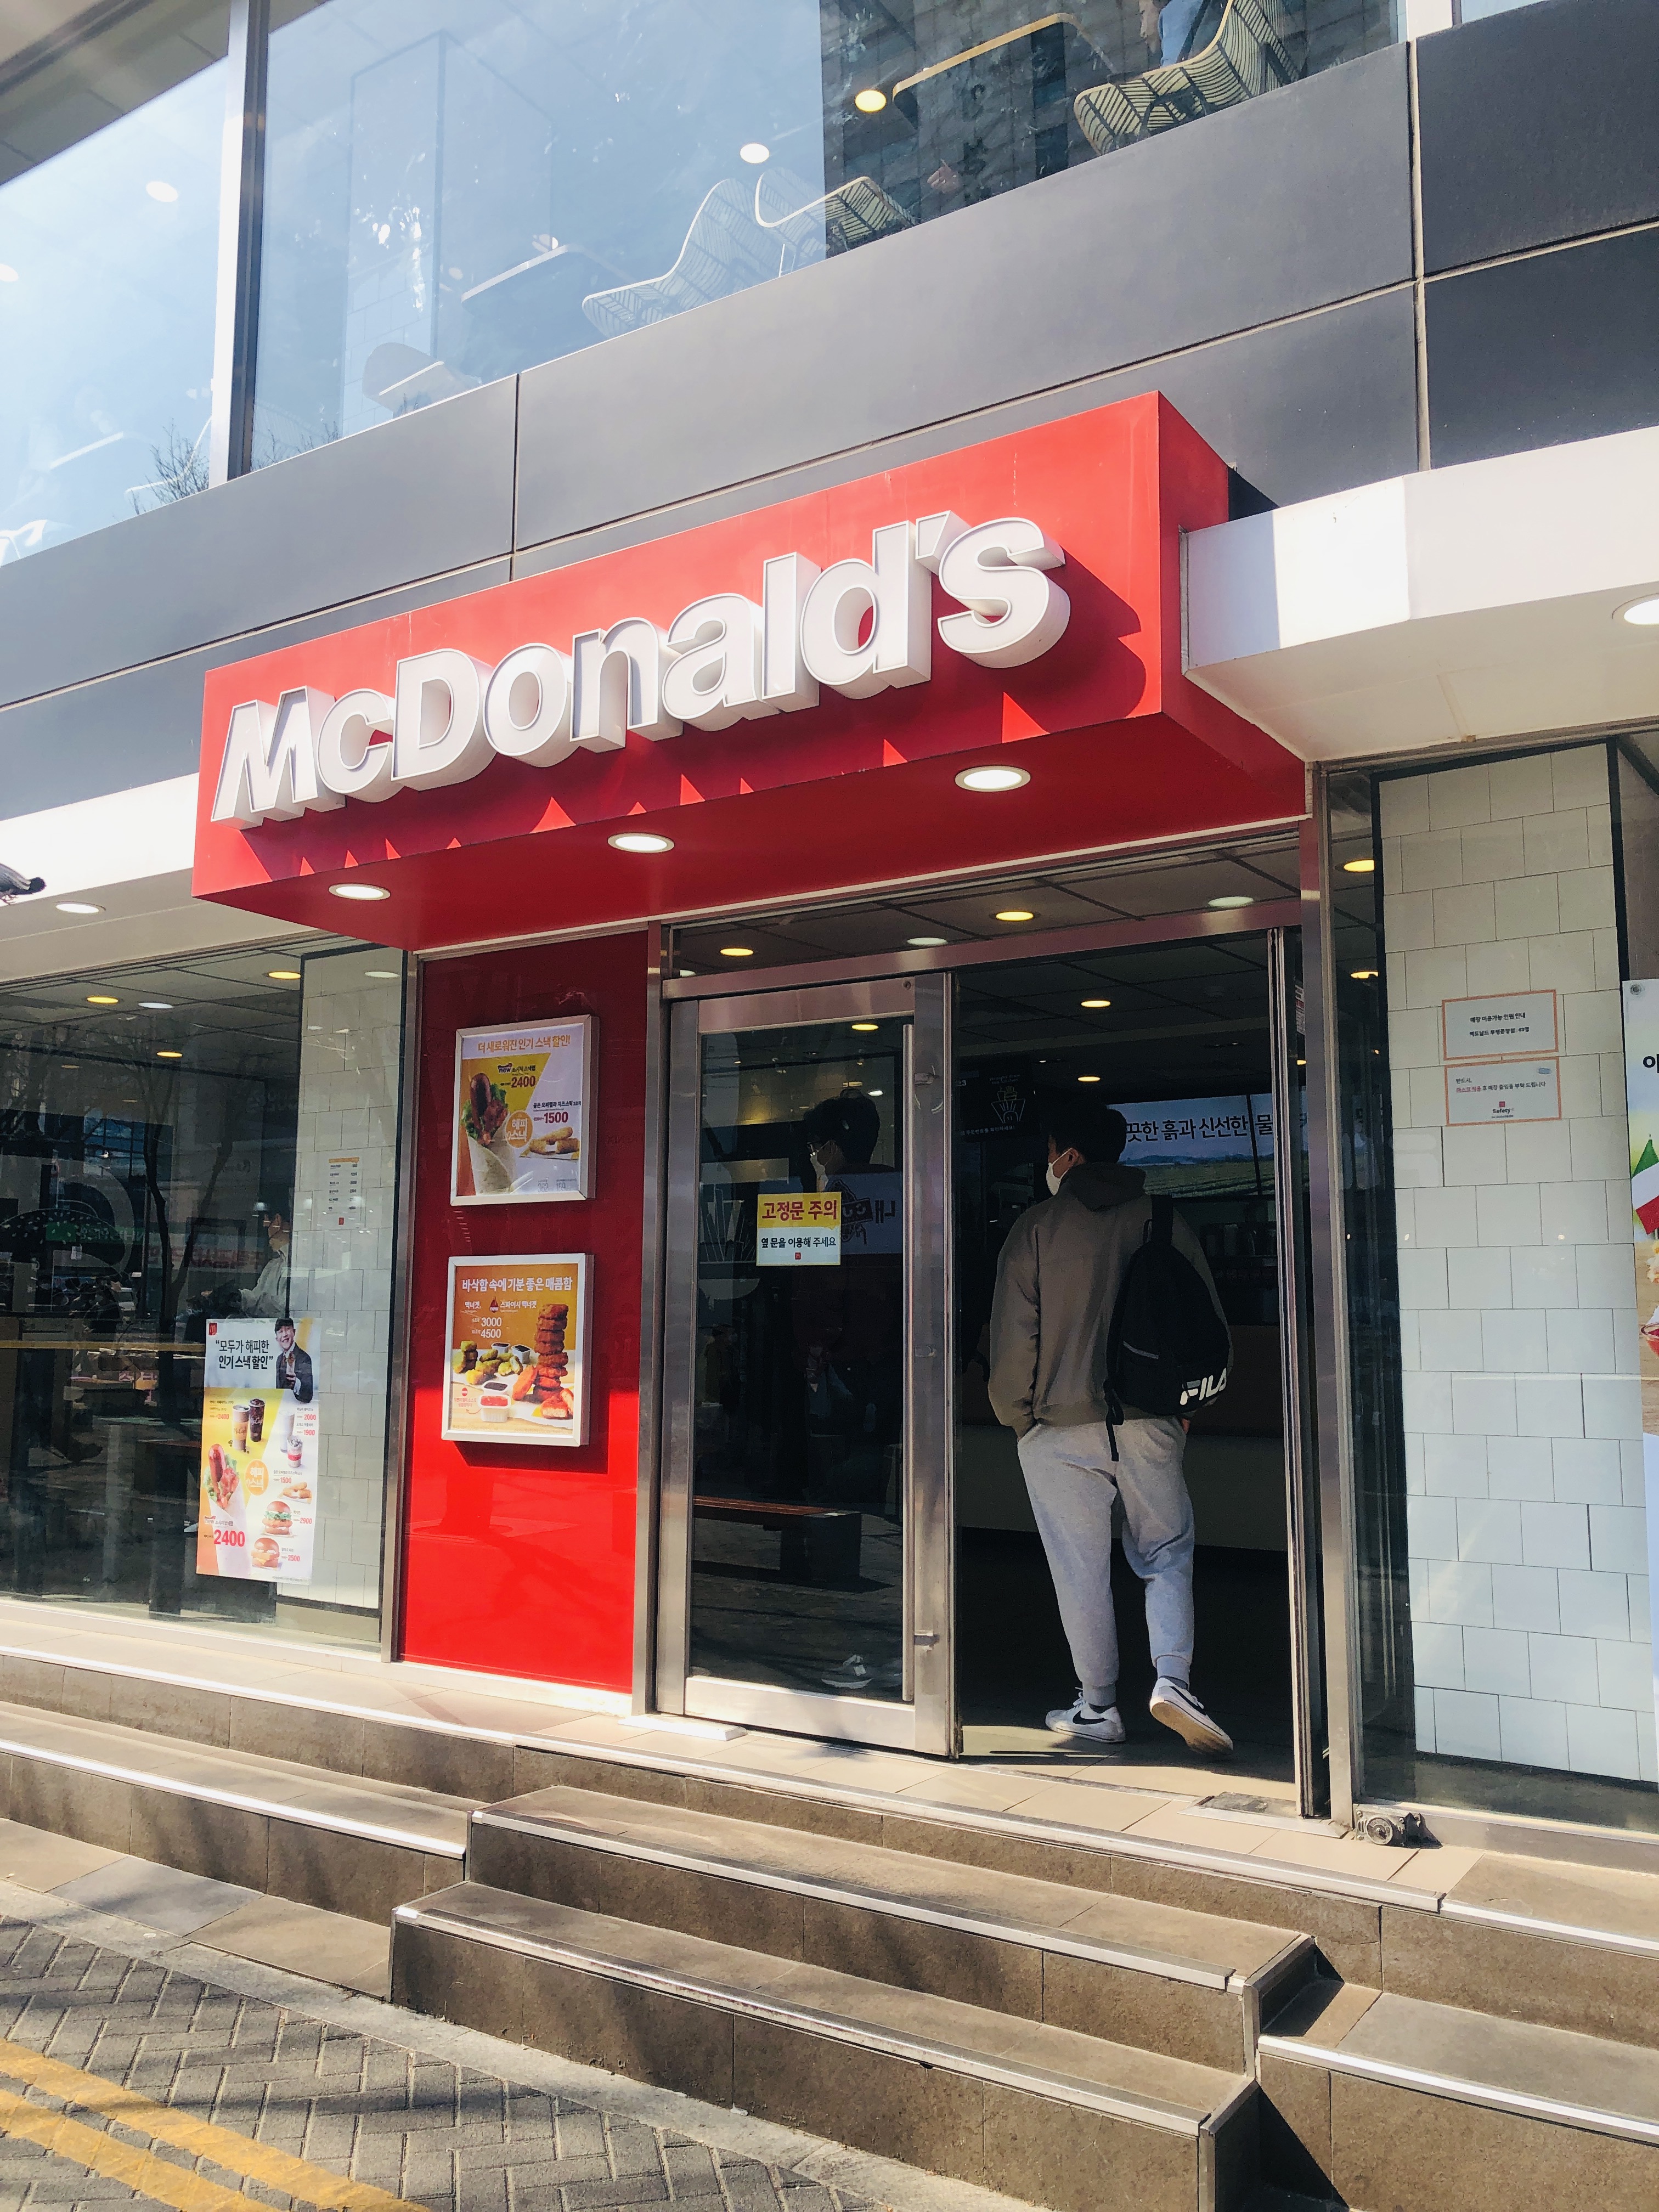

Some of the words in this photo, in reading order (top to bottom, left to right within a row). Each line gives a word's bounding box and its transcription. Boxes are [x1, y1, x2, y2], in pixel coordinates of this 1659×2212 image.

[211, 510, 1070, 830] McDonald's
[478, 1042, 486, 1053] 더
[487, 1039, 517, 1053] 새로워진
[518, 1038, 534, 1049] 인기
[535, 1036, 551, 1048] 스낵
[511, 1075, 536, 1088] 2400
[511, 1118, 528, 1130] 해피
[544, 1111, 568, 1124] 1500
[1161, 1118, 1196, 1141] 흙과
[1199, 1115, 1249, 1139] 신선한
[1255, 1113, 1273, 1136] 물
[761, 1201, 805, 1221] 고정문
[808, 1199, 837, 1220] 주의
[761, 1238, 769, 1248] 옆
[770, 1237, 786, 1248] 문을
[788, 1237, 811, 1248] 이용해
[812, 1237, 837, 1248] 주세요
[462, 1278, 488, 1292] 바삭함
[489, 1278, 506, 1291] 속에
[507, 1277, 524, 1291] 기분
[526, 1277, 544, 1291] 좋은
[545, 1276, 573, 1291] 매콤함
[481, 1317, 502, 1327] 3000
[481, 1329, 501, 1339] 4500
[245, 1340, 269, 1354] 해피한
[219, 1355, 234, 1369] 인기
[235, 1355, 251, 1369] 스낵
[1180, 1367, 1227, 1406] FILA
[213, 1529, 245, 1547] 2400
